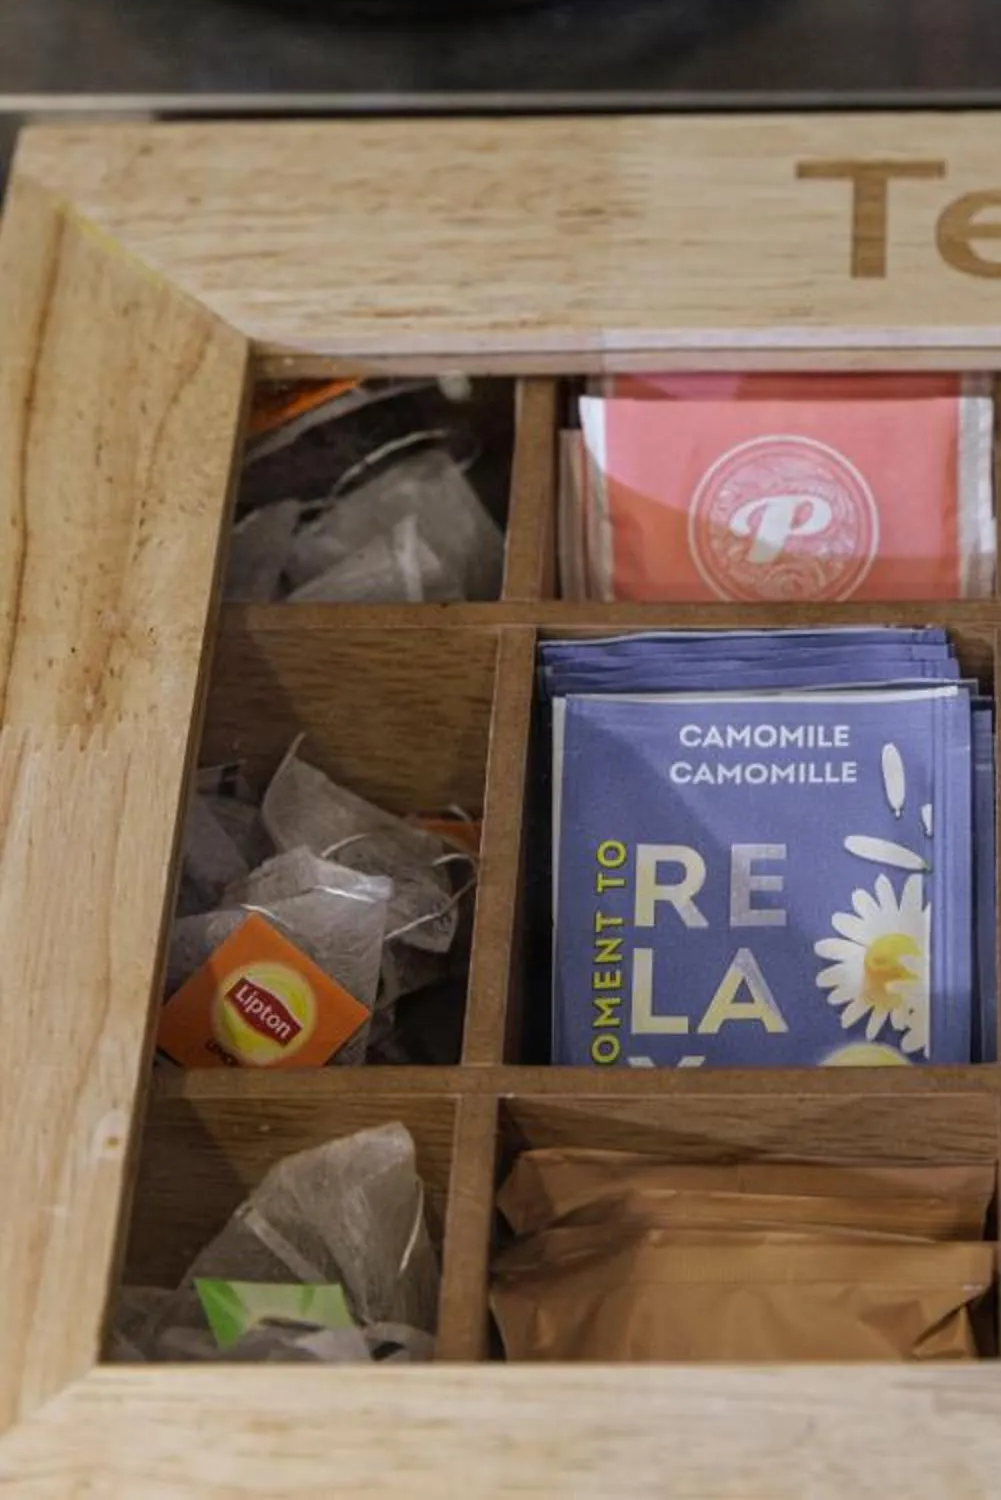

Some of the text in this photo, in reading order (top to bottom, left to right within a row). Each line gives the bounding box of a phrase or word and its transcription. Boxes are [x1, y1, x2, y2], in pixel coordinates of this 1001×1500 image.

[678, 723, 851, 748] CAMOMILE
[669, 760, 858, 785] CAMOMILLE
[596, 839, 627, 893] TO
[634, 843, 788, 928] RE
[235, 984, 291, 1039] Lipton
[631, 947, 789, 1035] LA
